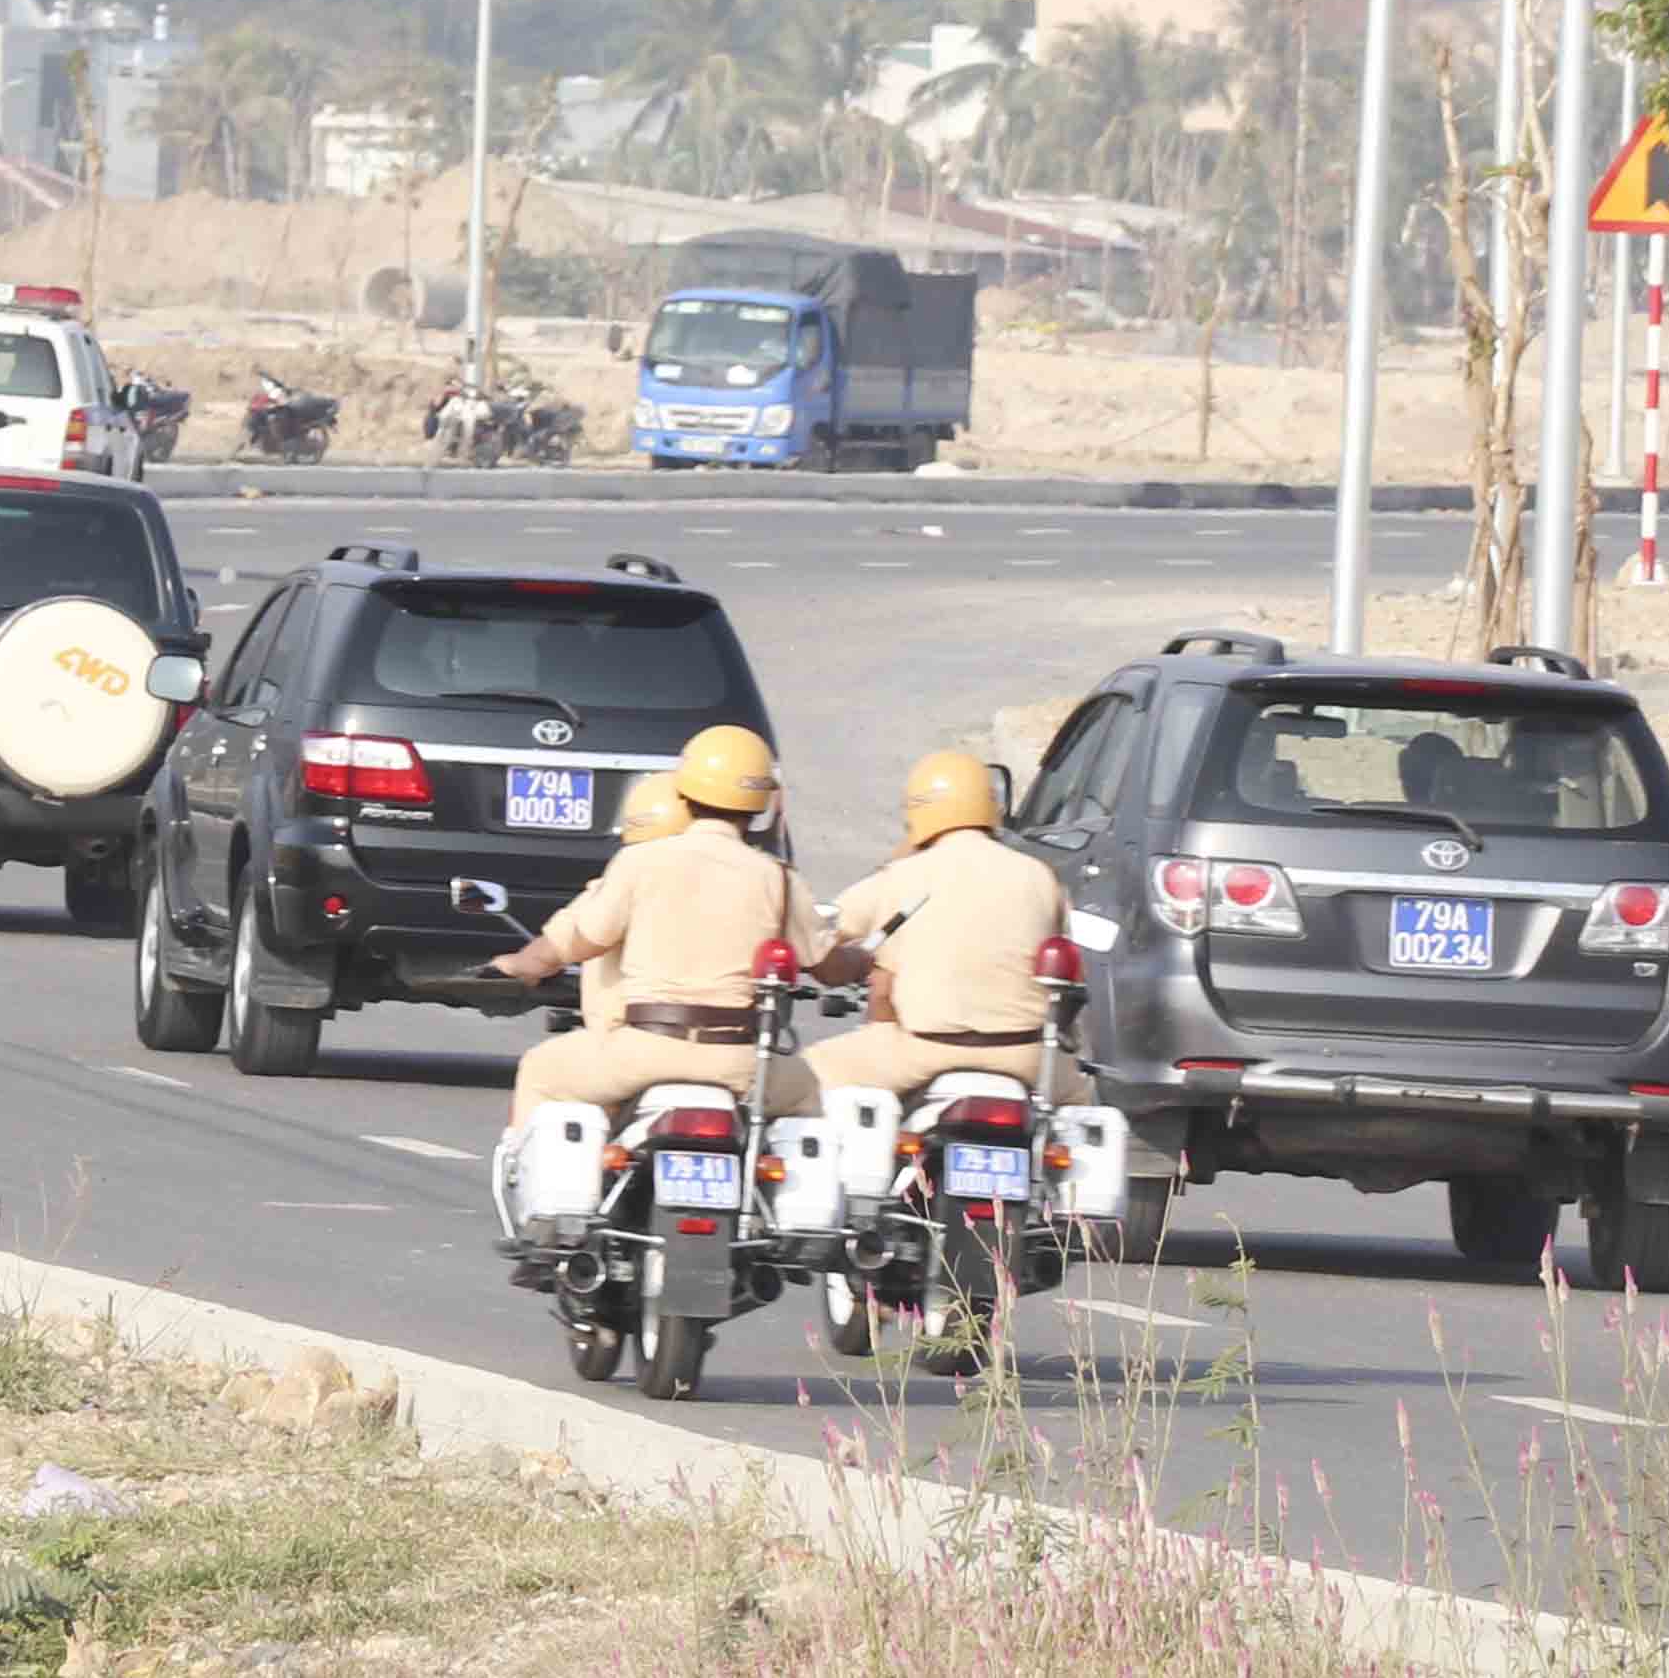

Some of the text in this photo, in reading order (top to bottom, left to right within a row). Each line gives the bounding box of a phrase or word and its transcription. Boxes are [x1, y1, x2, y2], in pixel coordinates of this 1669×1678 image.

[59, 645, 130, 696] 4WD
[526, 770, 573, 797] 79A
[1414, 901, 1469, 931] 79A
